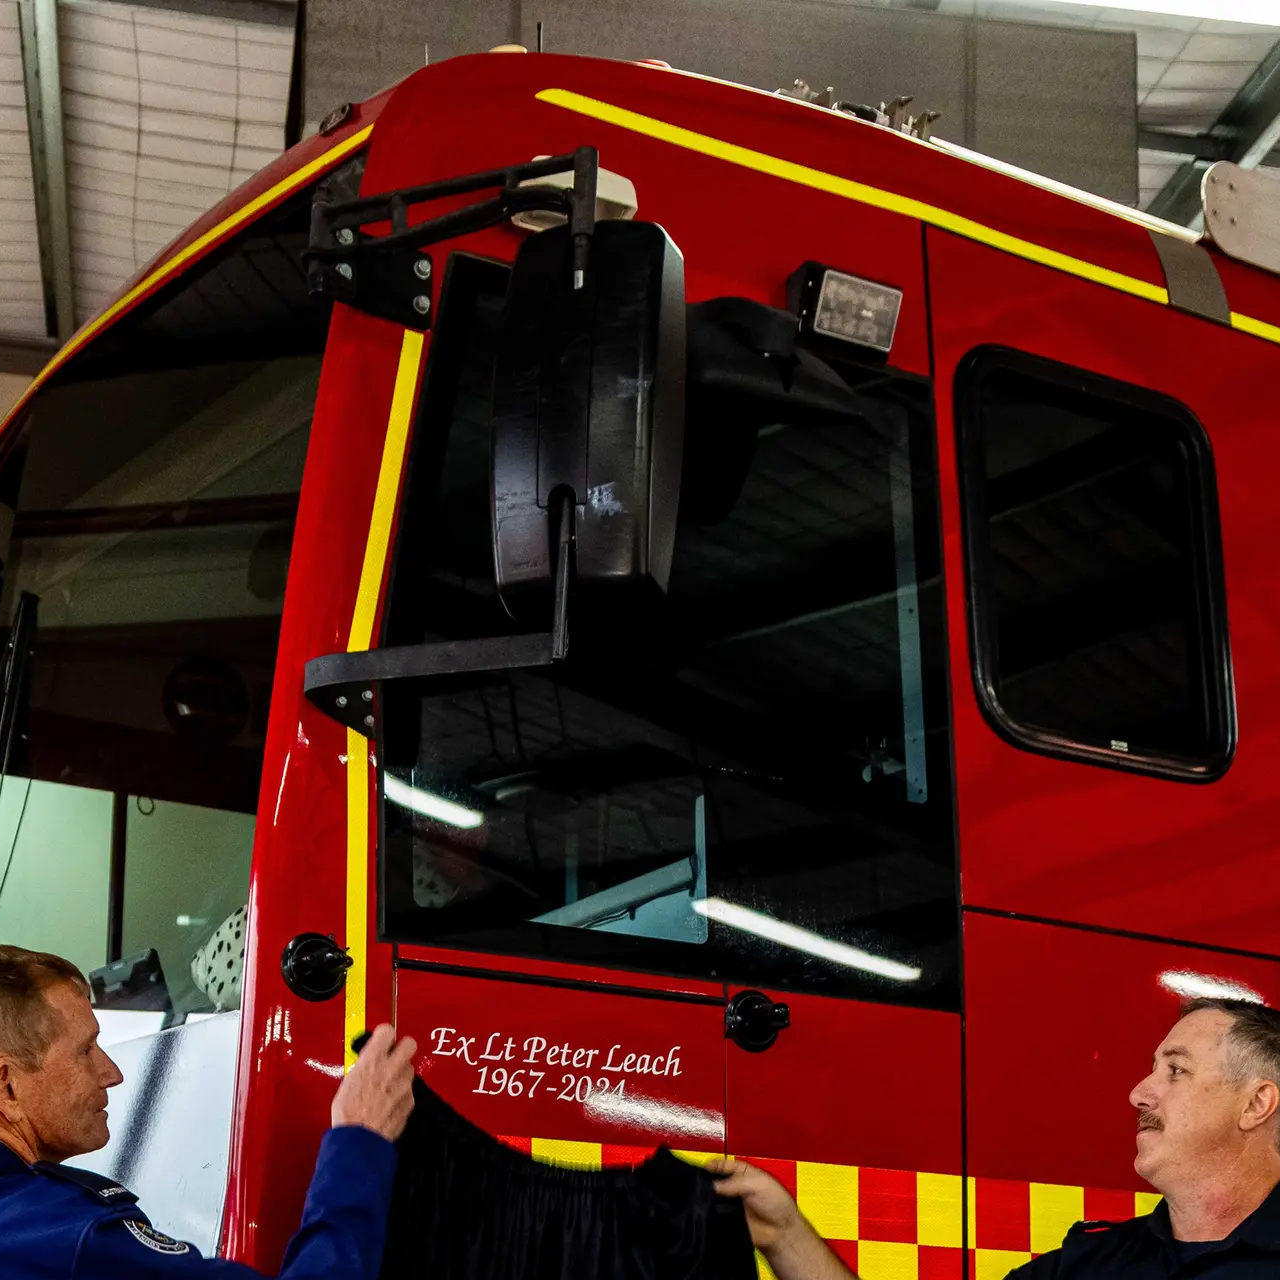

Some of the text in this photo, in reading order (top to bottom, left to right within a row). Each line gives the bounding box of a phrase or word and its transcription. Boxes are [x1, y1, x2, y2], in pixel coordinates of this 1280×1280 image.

[430, 1027, 683, 1077] Ex Lt Peter Leach
[472, 1066, 626, 1103] 1967-2024
